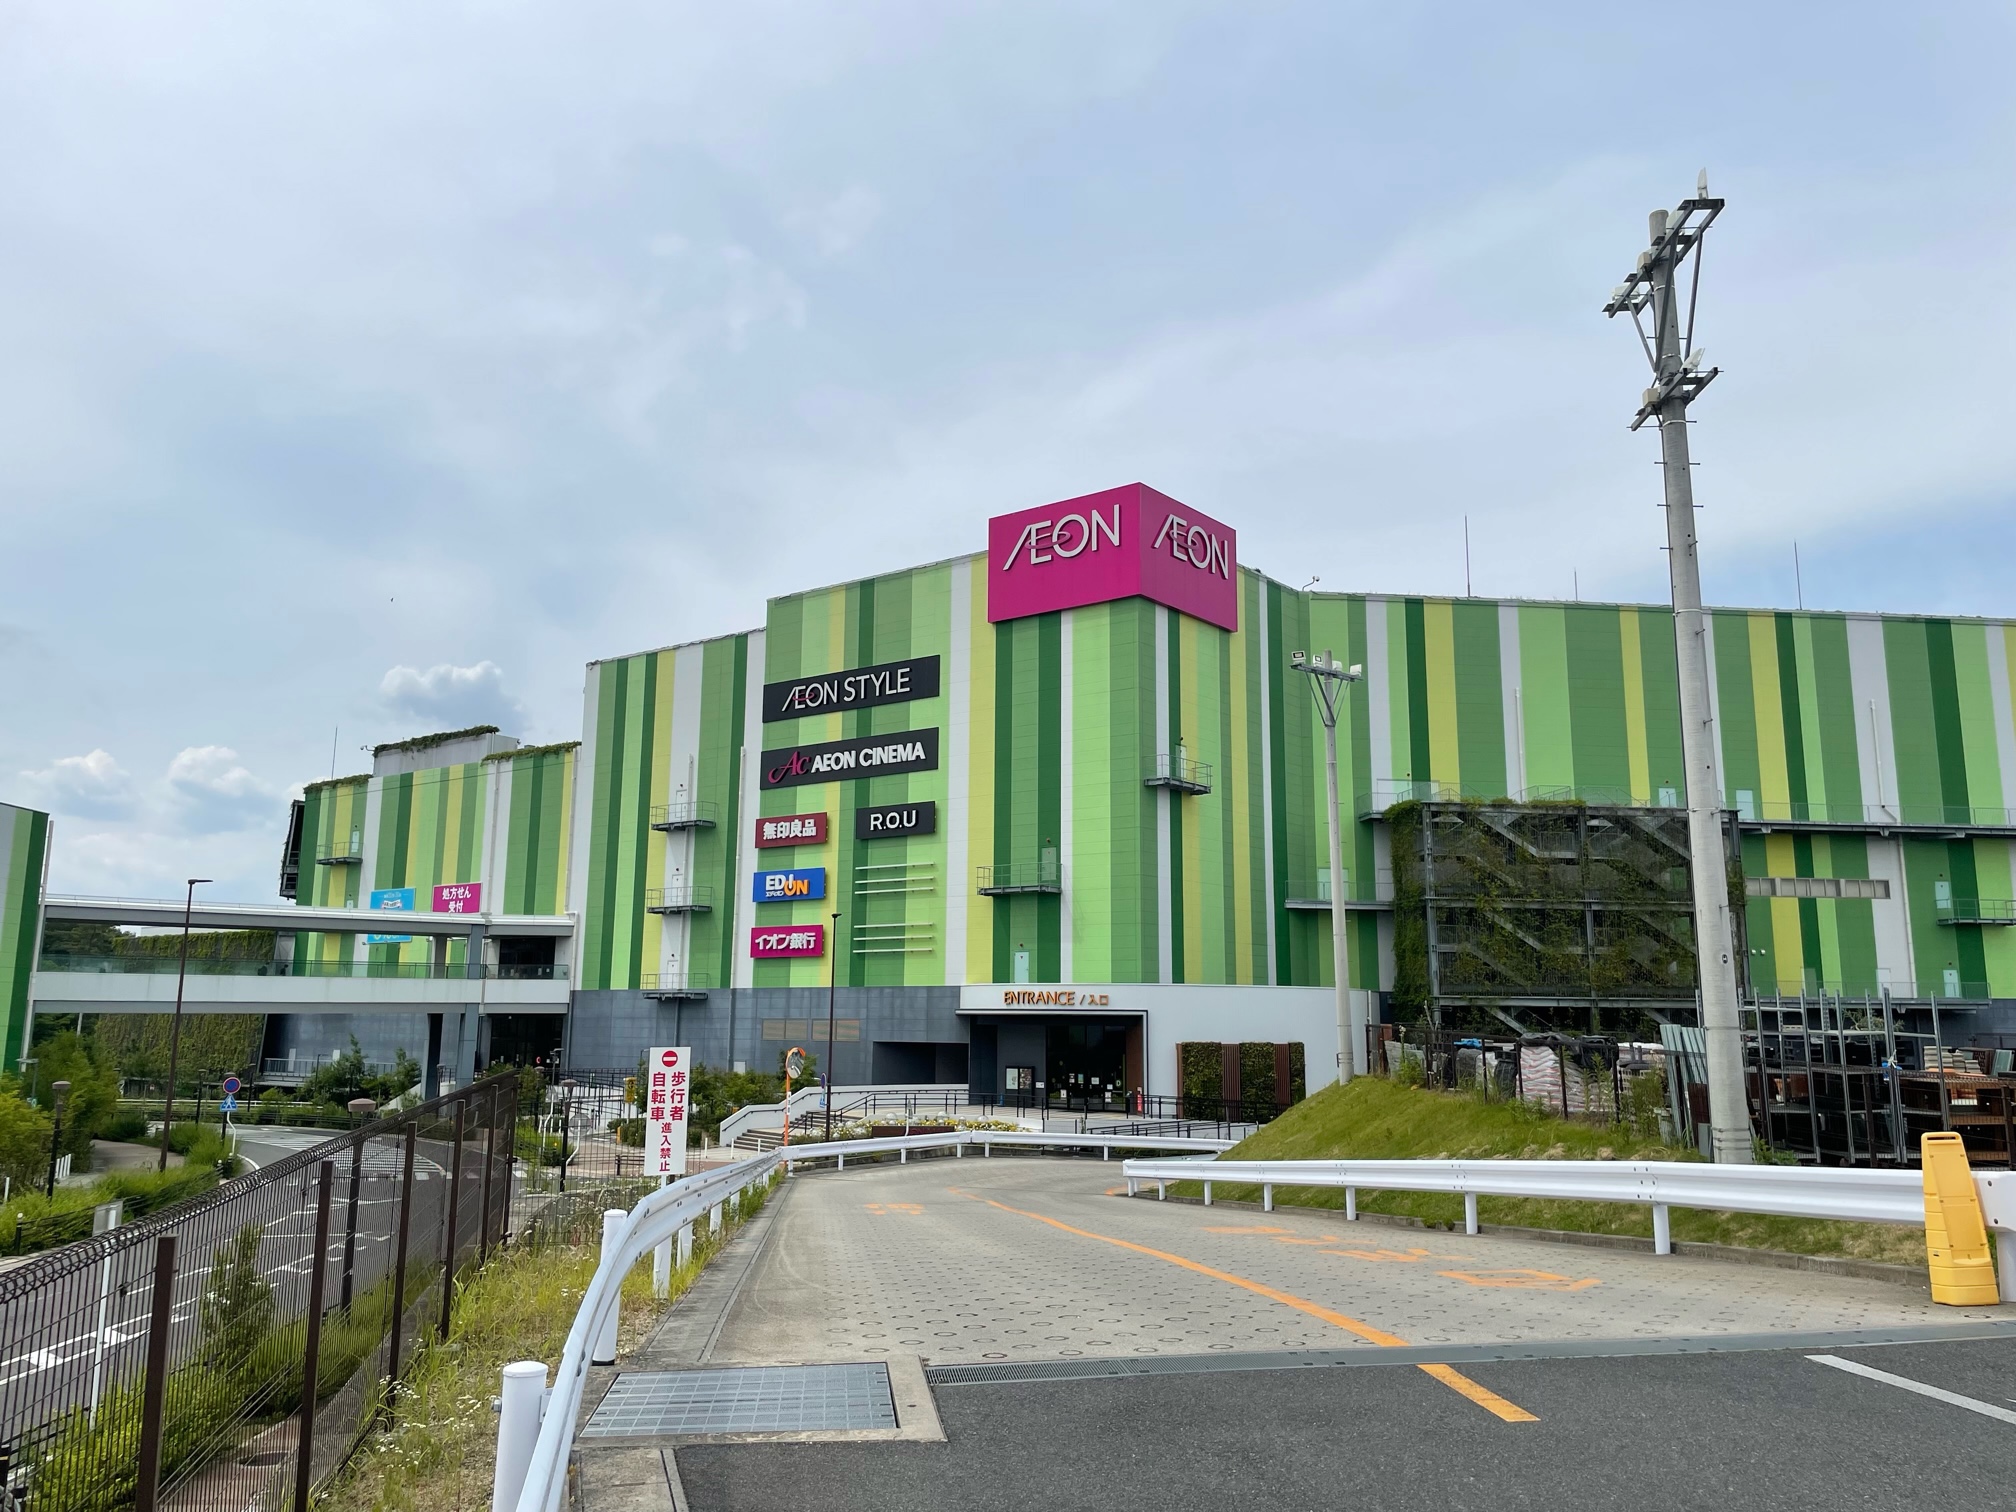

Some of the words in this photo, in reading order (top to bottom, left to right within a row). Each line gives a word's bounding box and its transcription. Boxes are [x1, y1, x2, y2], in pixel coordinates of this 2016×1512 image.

[843, 667, 911, 702] STYLE
[810, 750, 856, 774] AEON
[859, 741, 926, 767] CINEMA
[763, 819, 817, 841] 無印良品
[870, 809, 917, 831] R.O.U
[442, 886, 471, 900] 処方せん
[448, 900, 464, 913] 受付
[755, 932, 816, 950] イオン銀行
[1003, 991, 1076, 1006] ENTRANCE
[1088, 994, 1109, 1006] 入口
[650, 1071, 666, 1122] 自転車
[669, 1071, 686, 1121] 歩行者
[659, 1122, 673, 1172] 進入禁止
